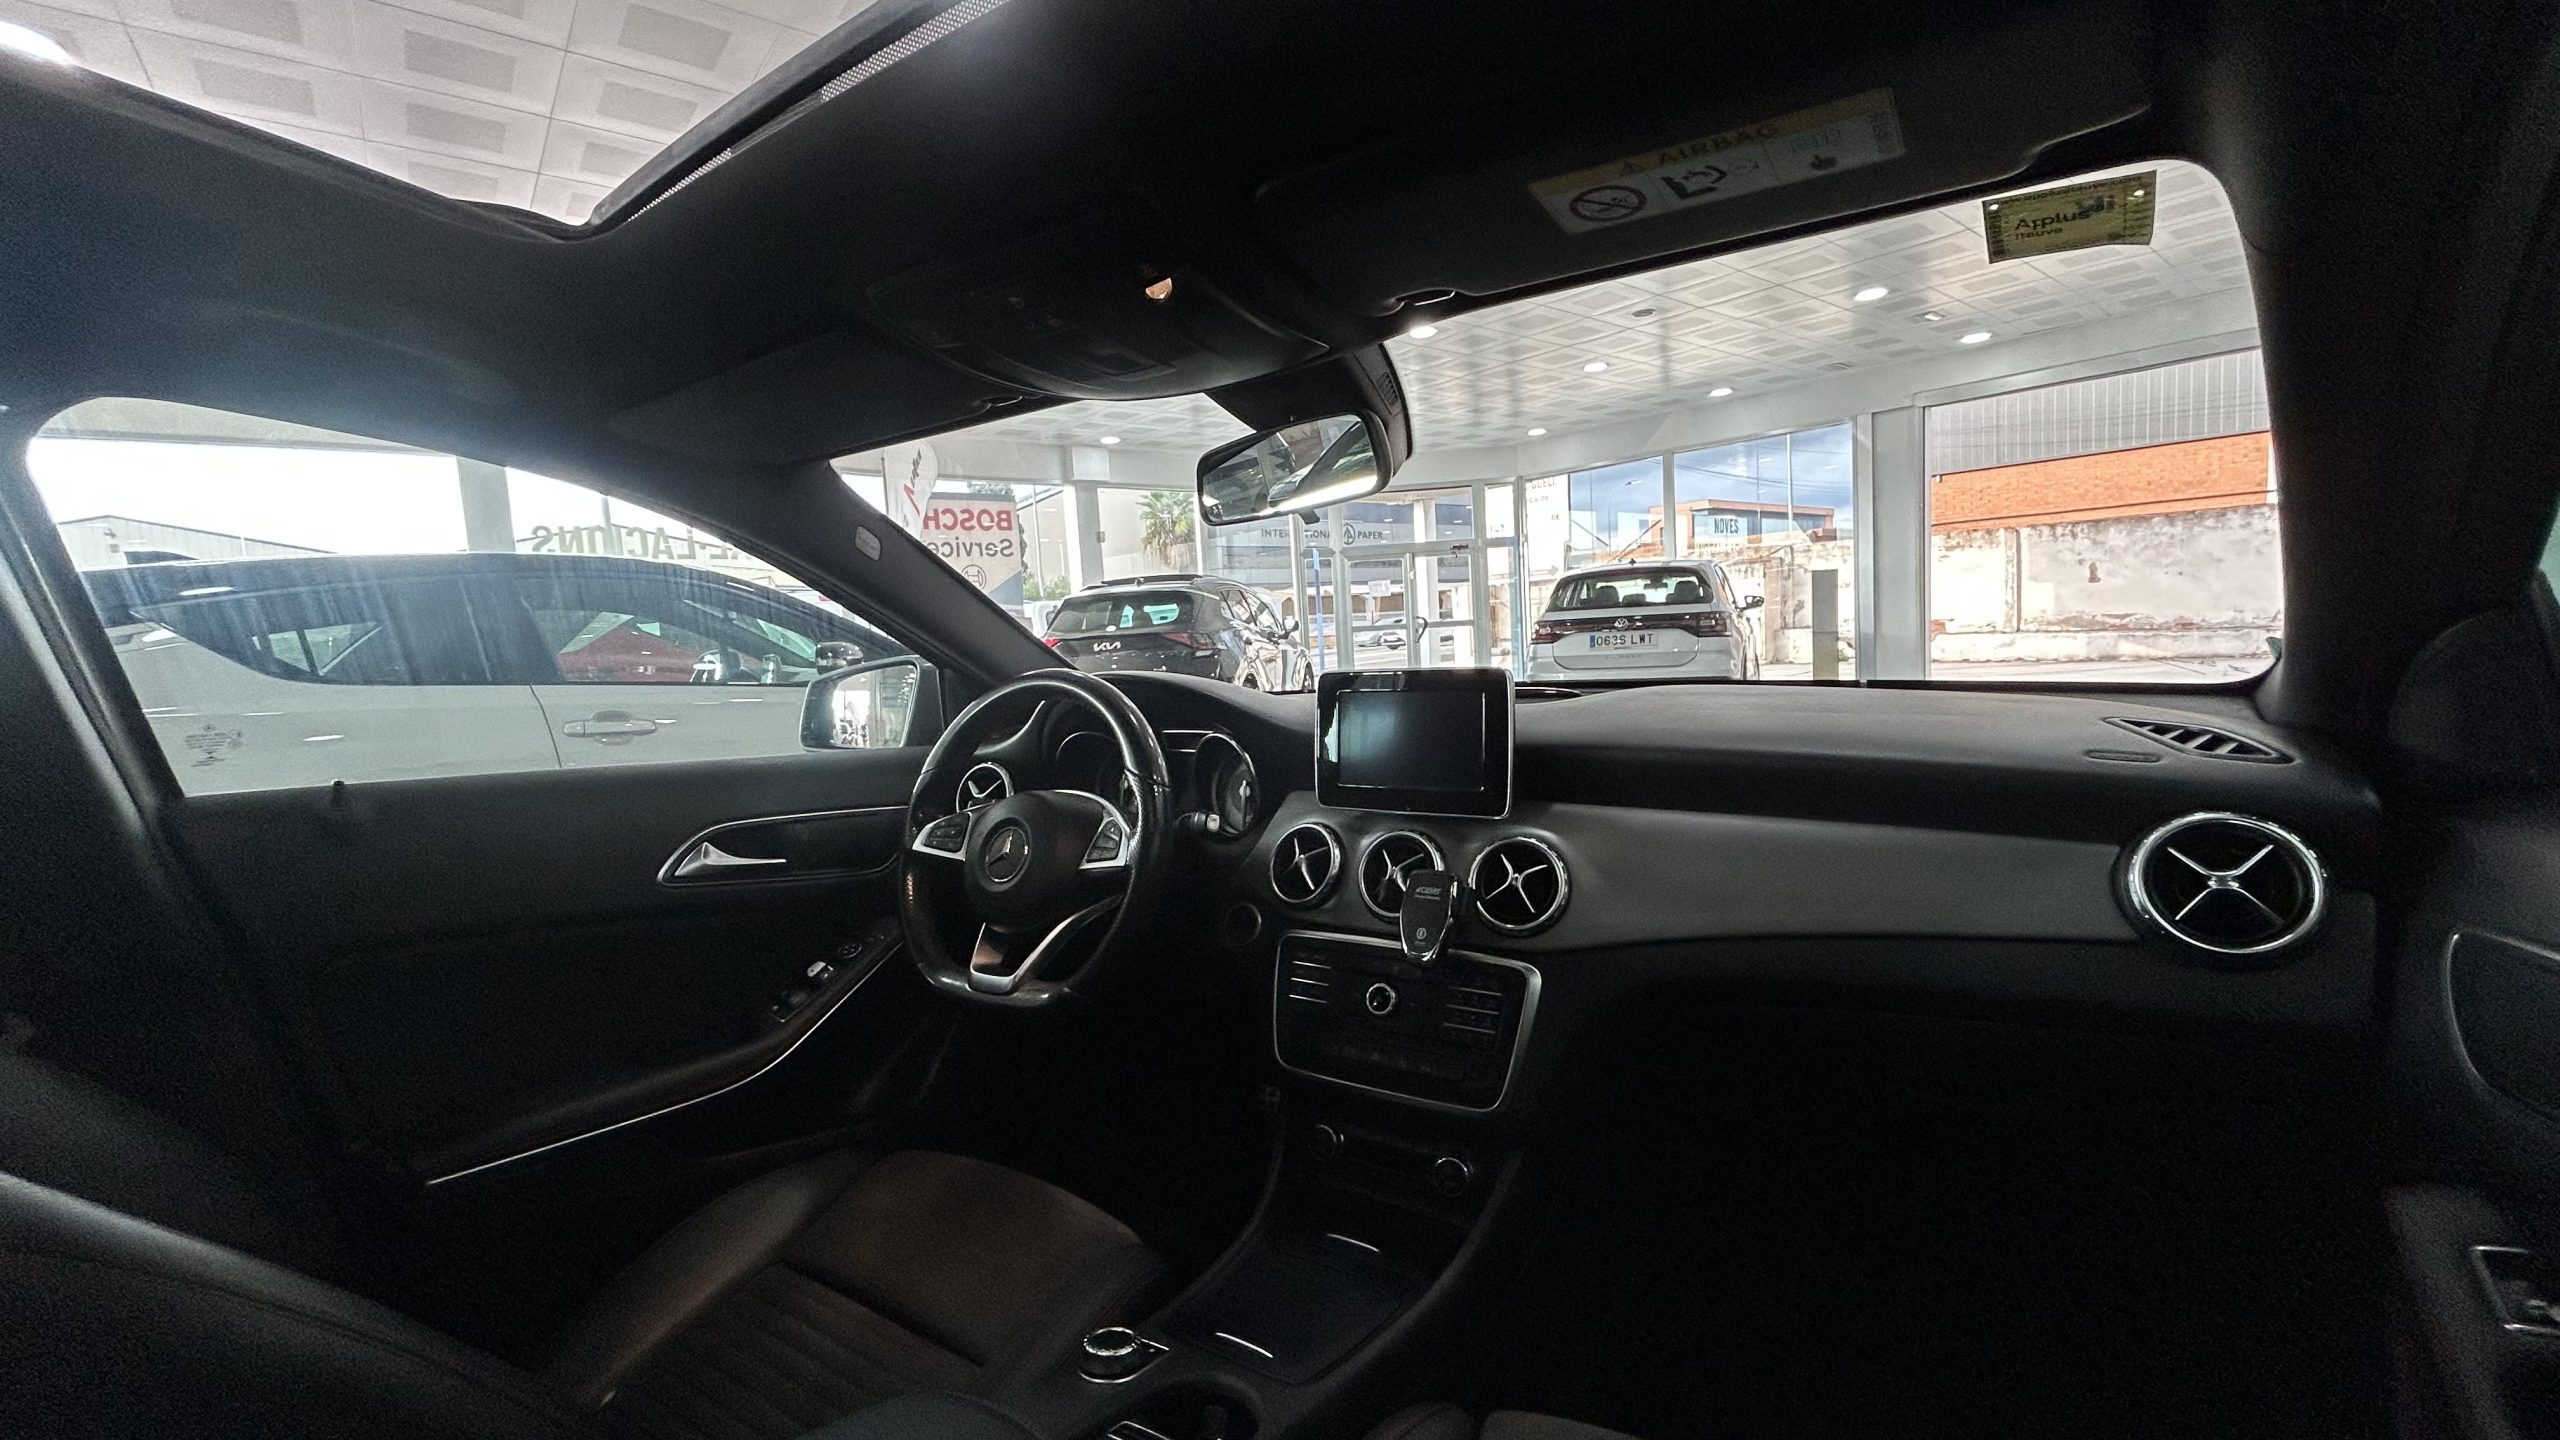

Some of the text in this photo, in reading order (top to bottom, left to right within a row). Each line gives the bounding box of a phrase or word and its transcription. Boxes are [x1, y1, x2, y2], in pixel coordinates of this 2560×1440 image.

[1658, 124, 1780, 166] AIRBAG
[2014, 209, 2092, 231] Applus
[1713, 517, 1739, 534] NOVES
[1357, 530, 1383, 540] PAPER
[1630, 633, 1654, 645] LWT
